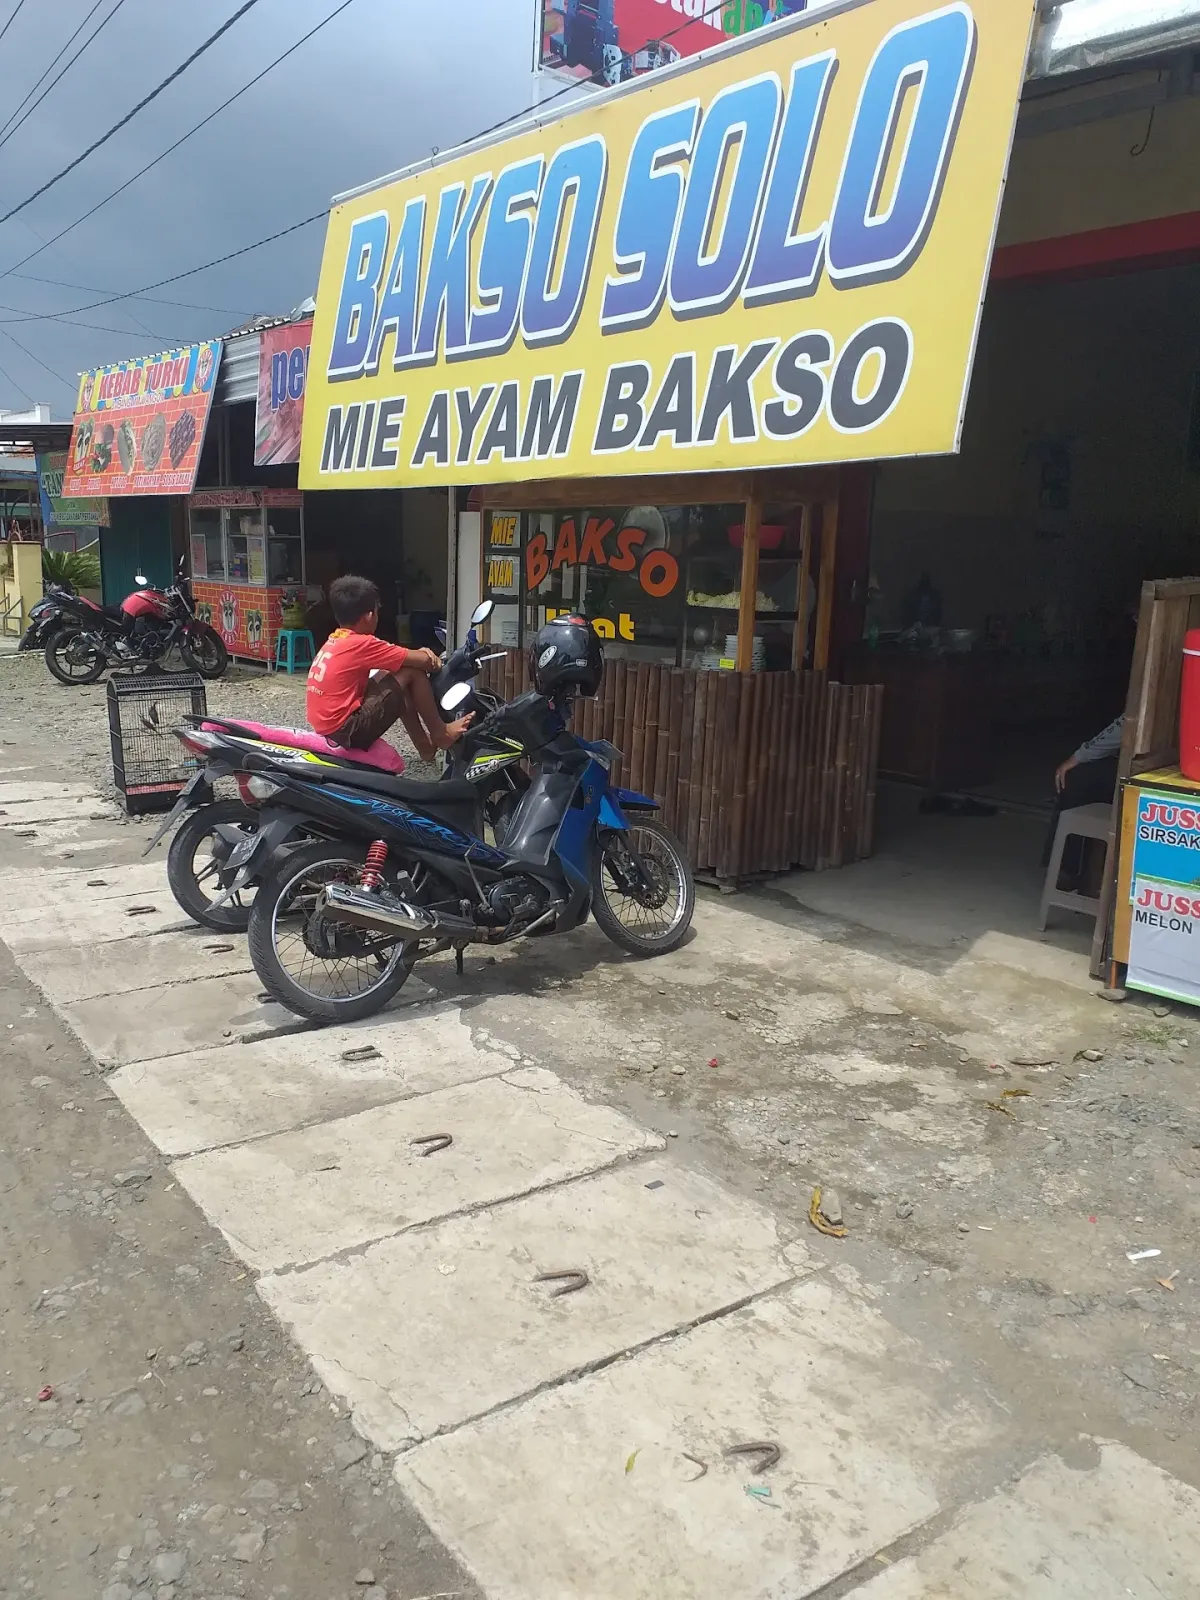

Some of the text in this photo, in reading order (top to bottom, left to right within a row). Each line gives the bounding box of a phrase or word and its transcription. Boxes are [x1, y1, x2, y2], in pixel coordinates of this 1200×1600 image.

[327, 1, 978, 381] BAKSO SOLO
[99, 367, 142, 400] KEBAB
[144, 355, 190, 393] TURKI
[319, 316, 914, 474] MIE AYAM BAKSO
[490, 517, 517, 545] MIE
[487, 559, 513, 587] AYAM
[526, 517, 679, 597] BAKSO
[1139, 825, 1200, 850] SIRSAK
[1135, 909, 1193, 934] MELON
